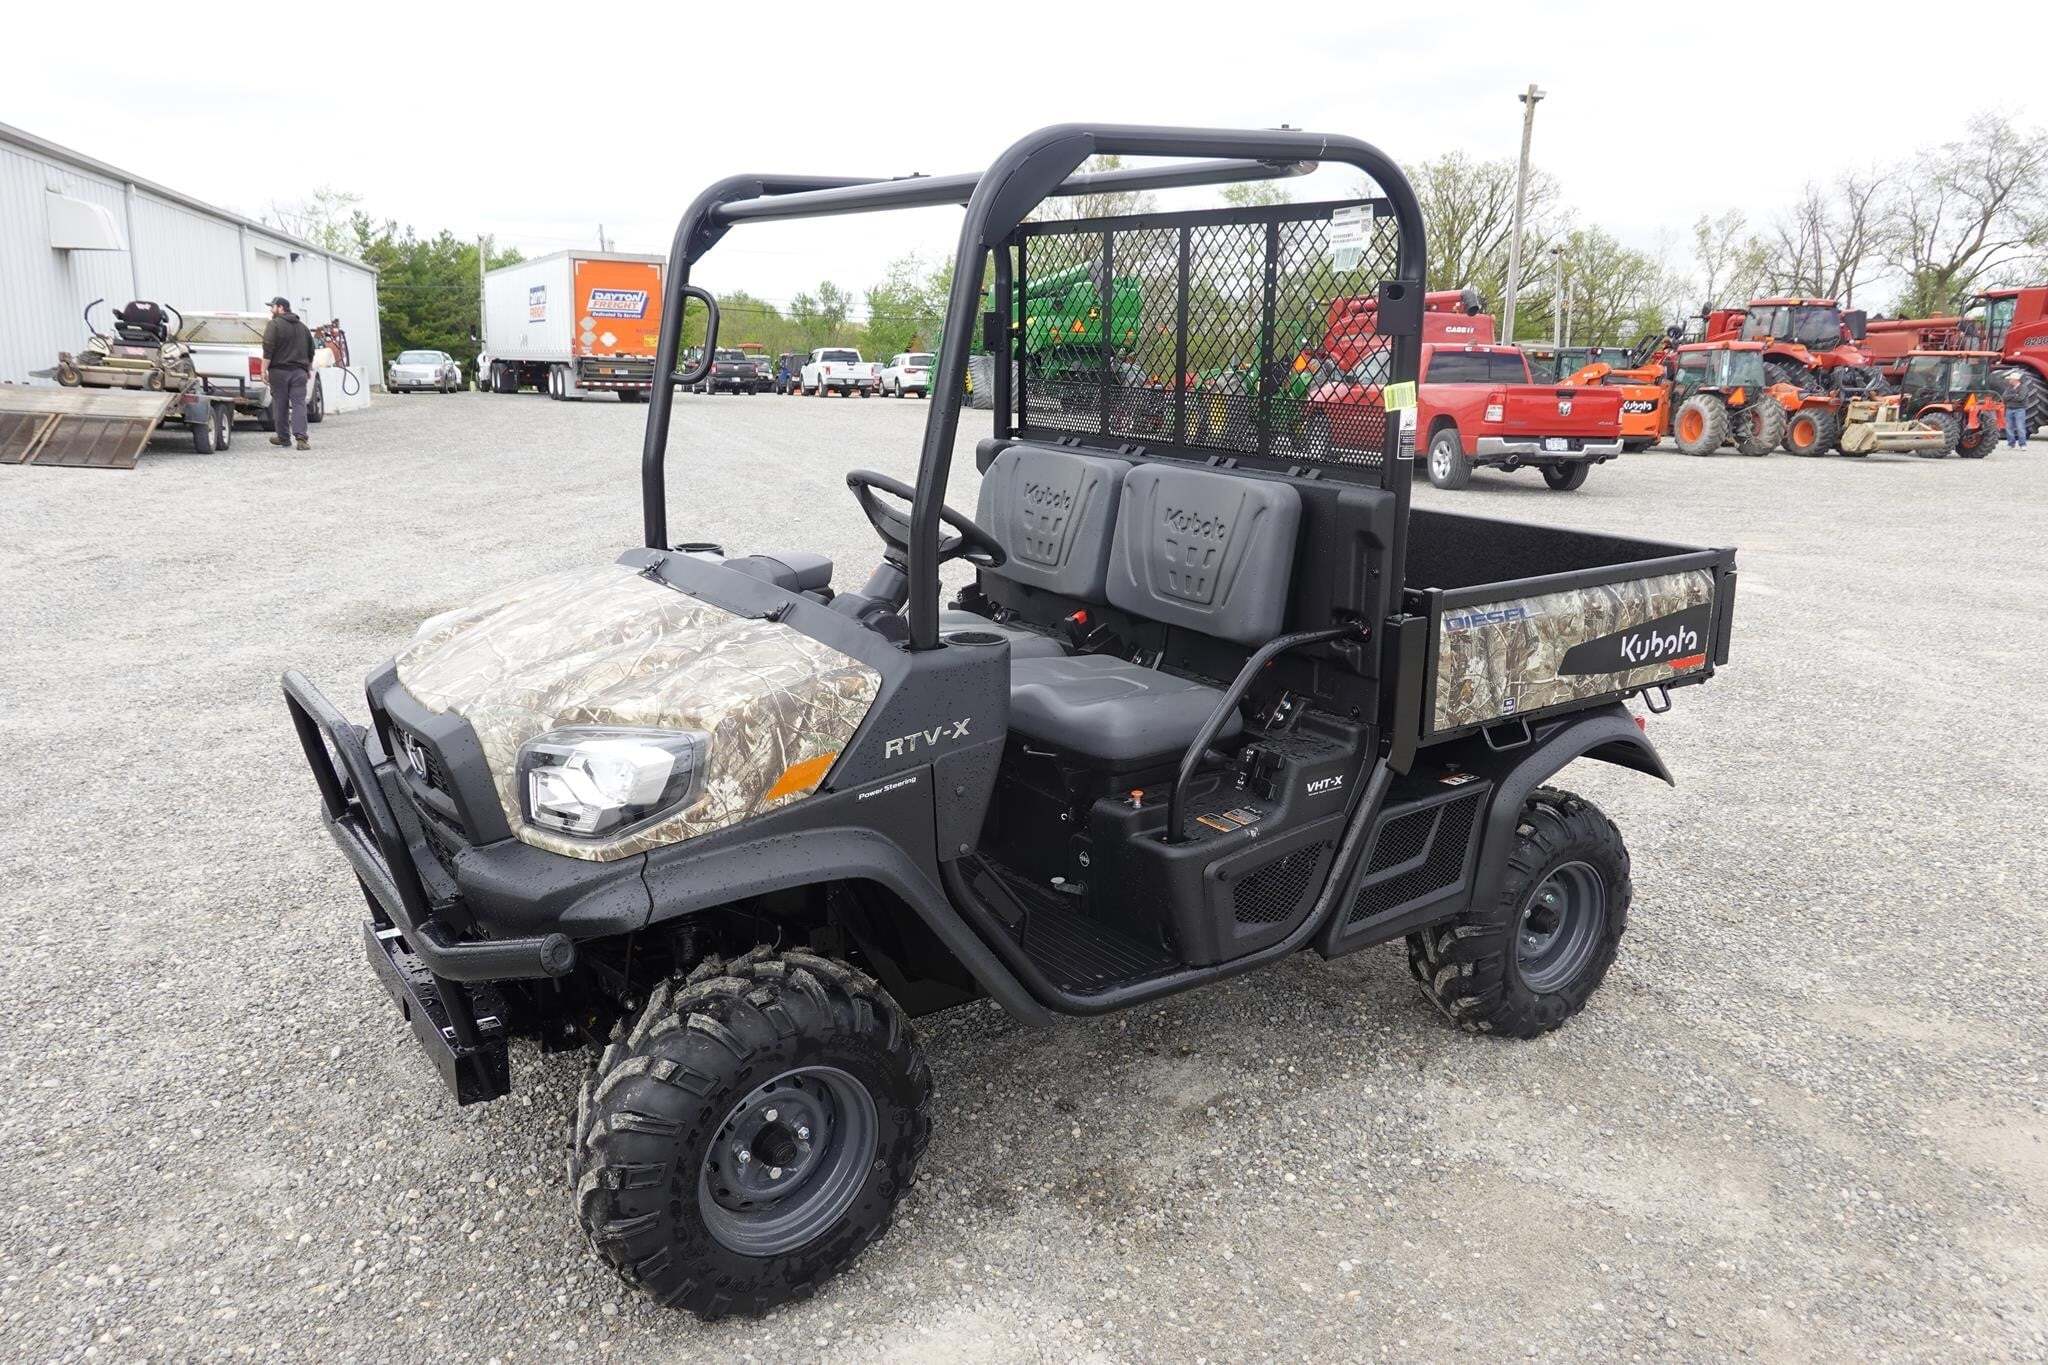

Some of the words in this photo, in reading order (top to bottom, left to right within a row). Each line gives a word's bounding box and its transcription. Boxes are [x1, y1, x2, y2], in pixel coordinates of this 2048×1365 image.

[593, 300, 639, 309] FREIGHT
[594, 292, 640, 301] DAYTON
[1024, 483, 1072, 509] Kubota
[1164, 507, 1226, 541] Kubota
[1621, 625, 1698, 663] Kubota
[885, 717, 971, 759] RTV-X
[858, 788, 884, 801] Power
[884, 776, 917, 792] Steering
[1307, 774, 1344, 793] VHT-X
